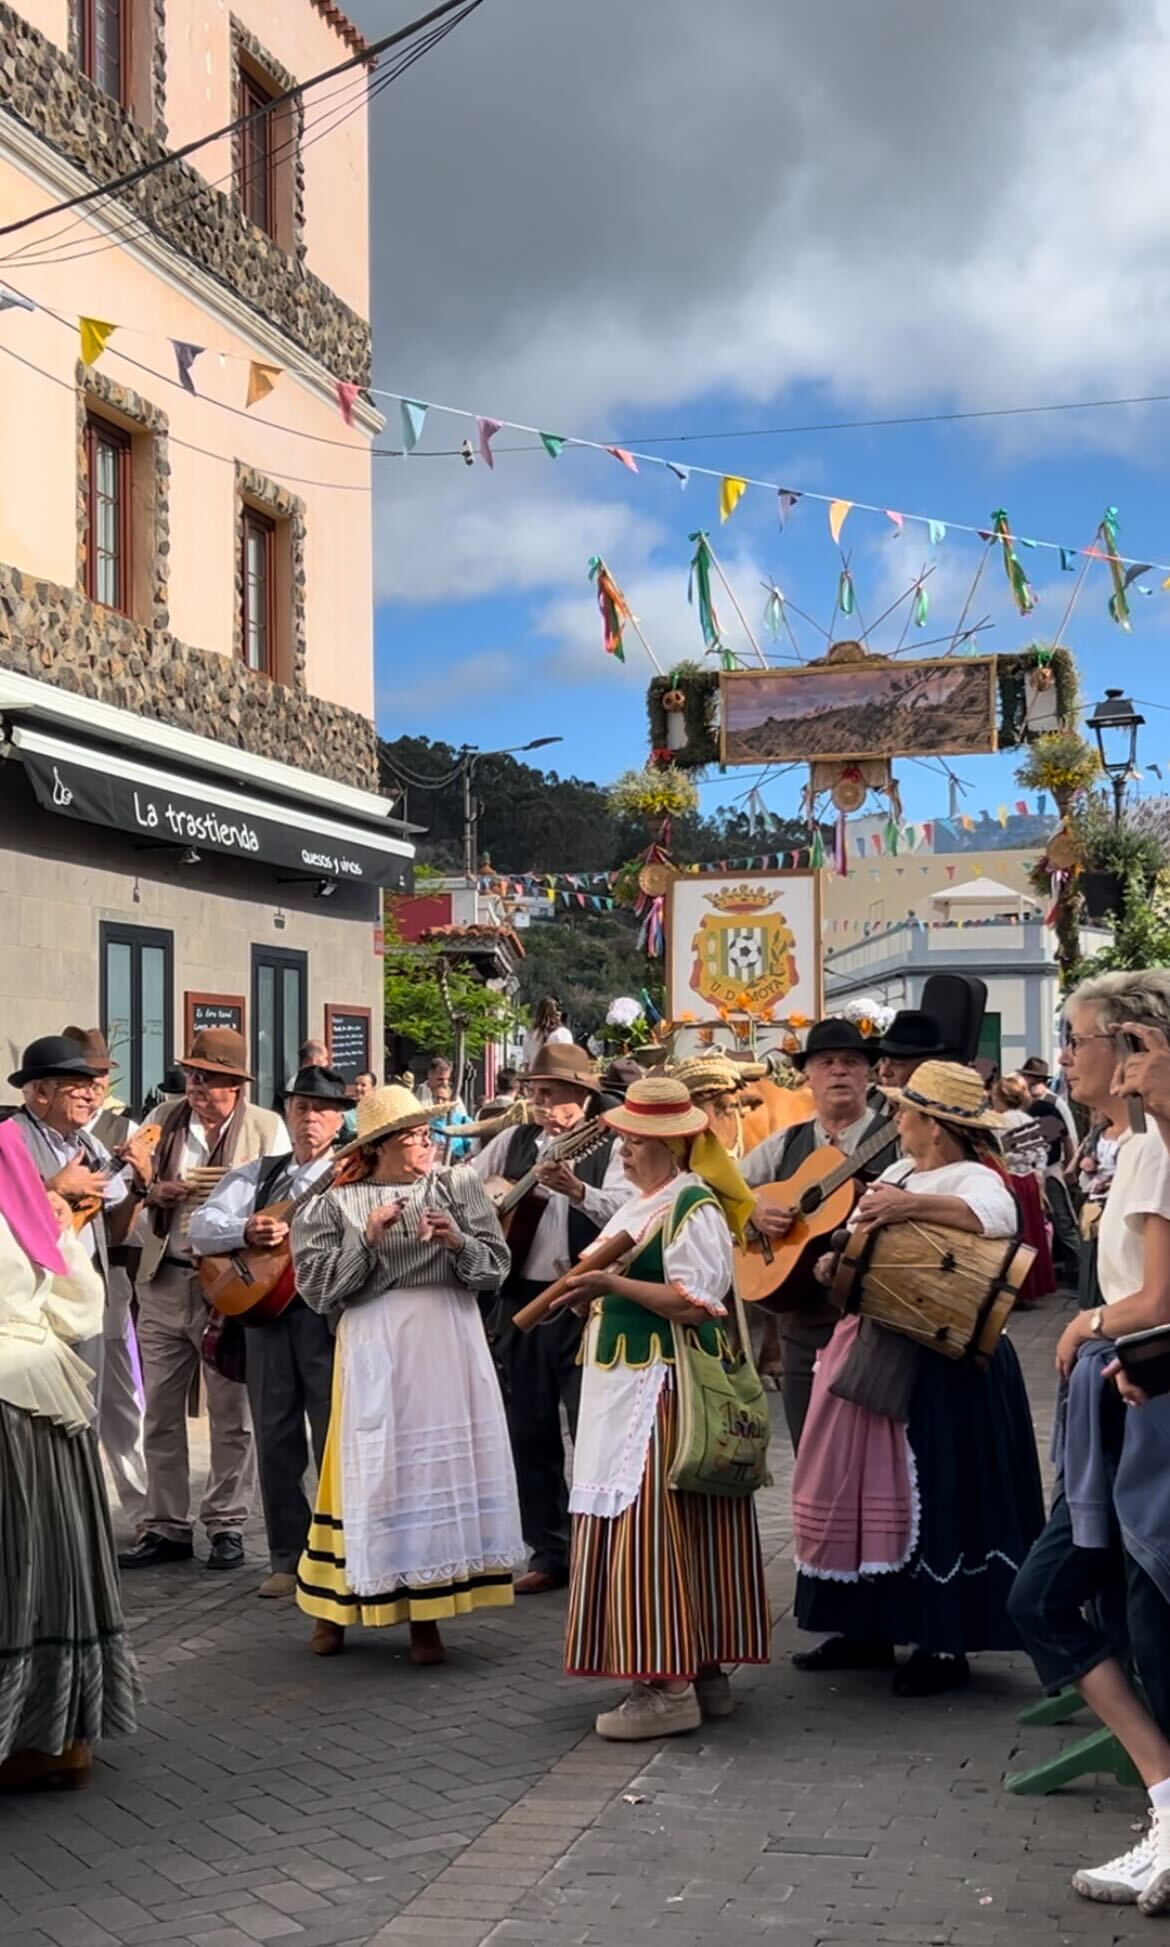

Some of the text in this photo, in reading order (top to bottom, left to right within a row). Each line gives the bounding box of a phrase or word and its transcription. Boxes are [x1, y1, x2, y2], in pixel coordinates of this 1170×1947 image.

[134, 791, 259, 851] La trastienda
[333, 857, 339, 875] y
[711, 981, 722, 993] U
[725, 990, 736, 1001] D
